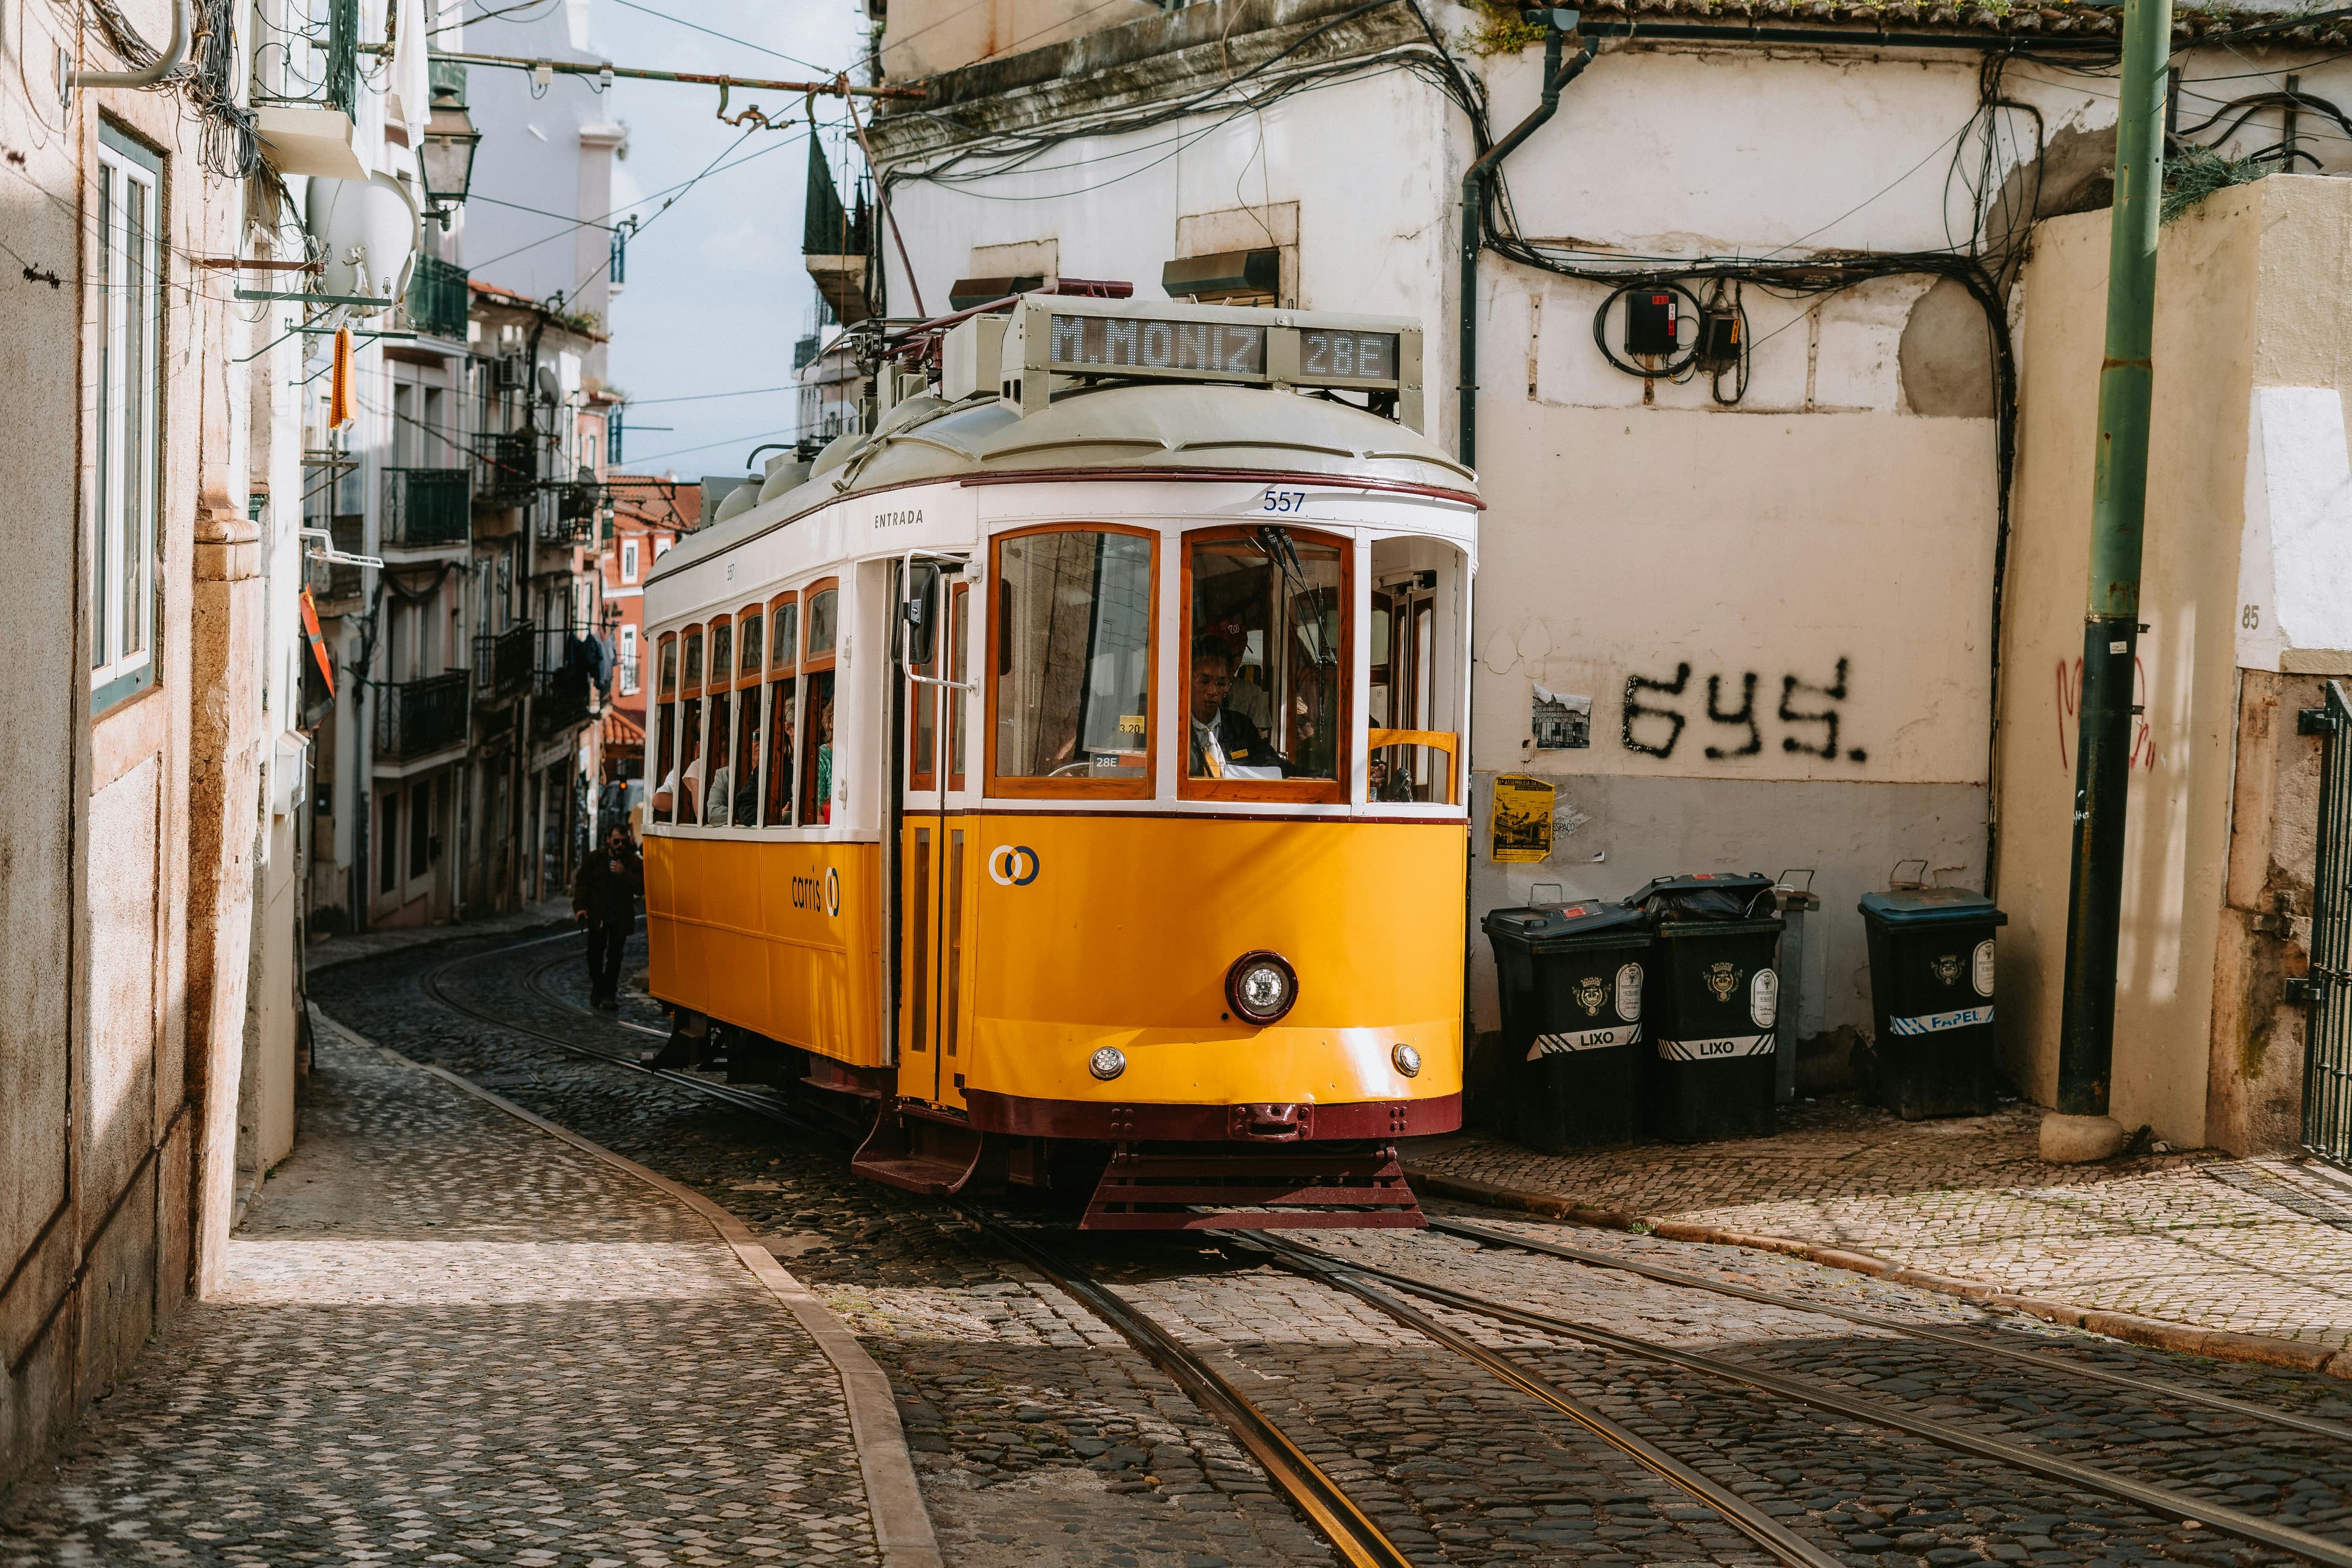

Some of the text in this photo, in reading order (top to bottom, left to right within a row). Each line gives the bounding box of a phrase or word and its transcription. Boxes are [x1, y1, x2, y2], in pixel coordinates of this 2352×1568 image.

[1051, 315, 1257, 374] M.MONIZ
[1307, 334, 1382, 377] 28E
[1264, 491, 1305, 513] 557
[874, 509, 924, 529] ENTRADA
[2242, 604, 2260, 630] 85
[1120, 725, 1140, 733] 3.20
[1096, 758, 1117, 767] 28E
[792, 865, 821, 912] carris
[1580, 1030, 1615, 1047] LIXO
[1699, 1041, 1735, 1056] LIXO
